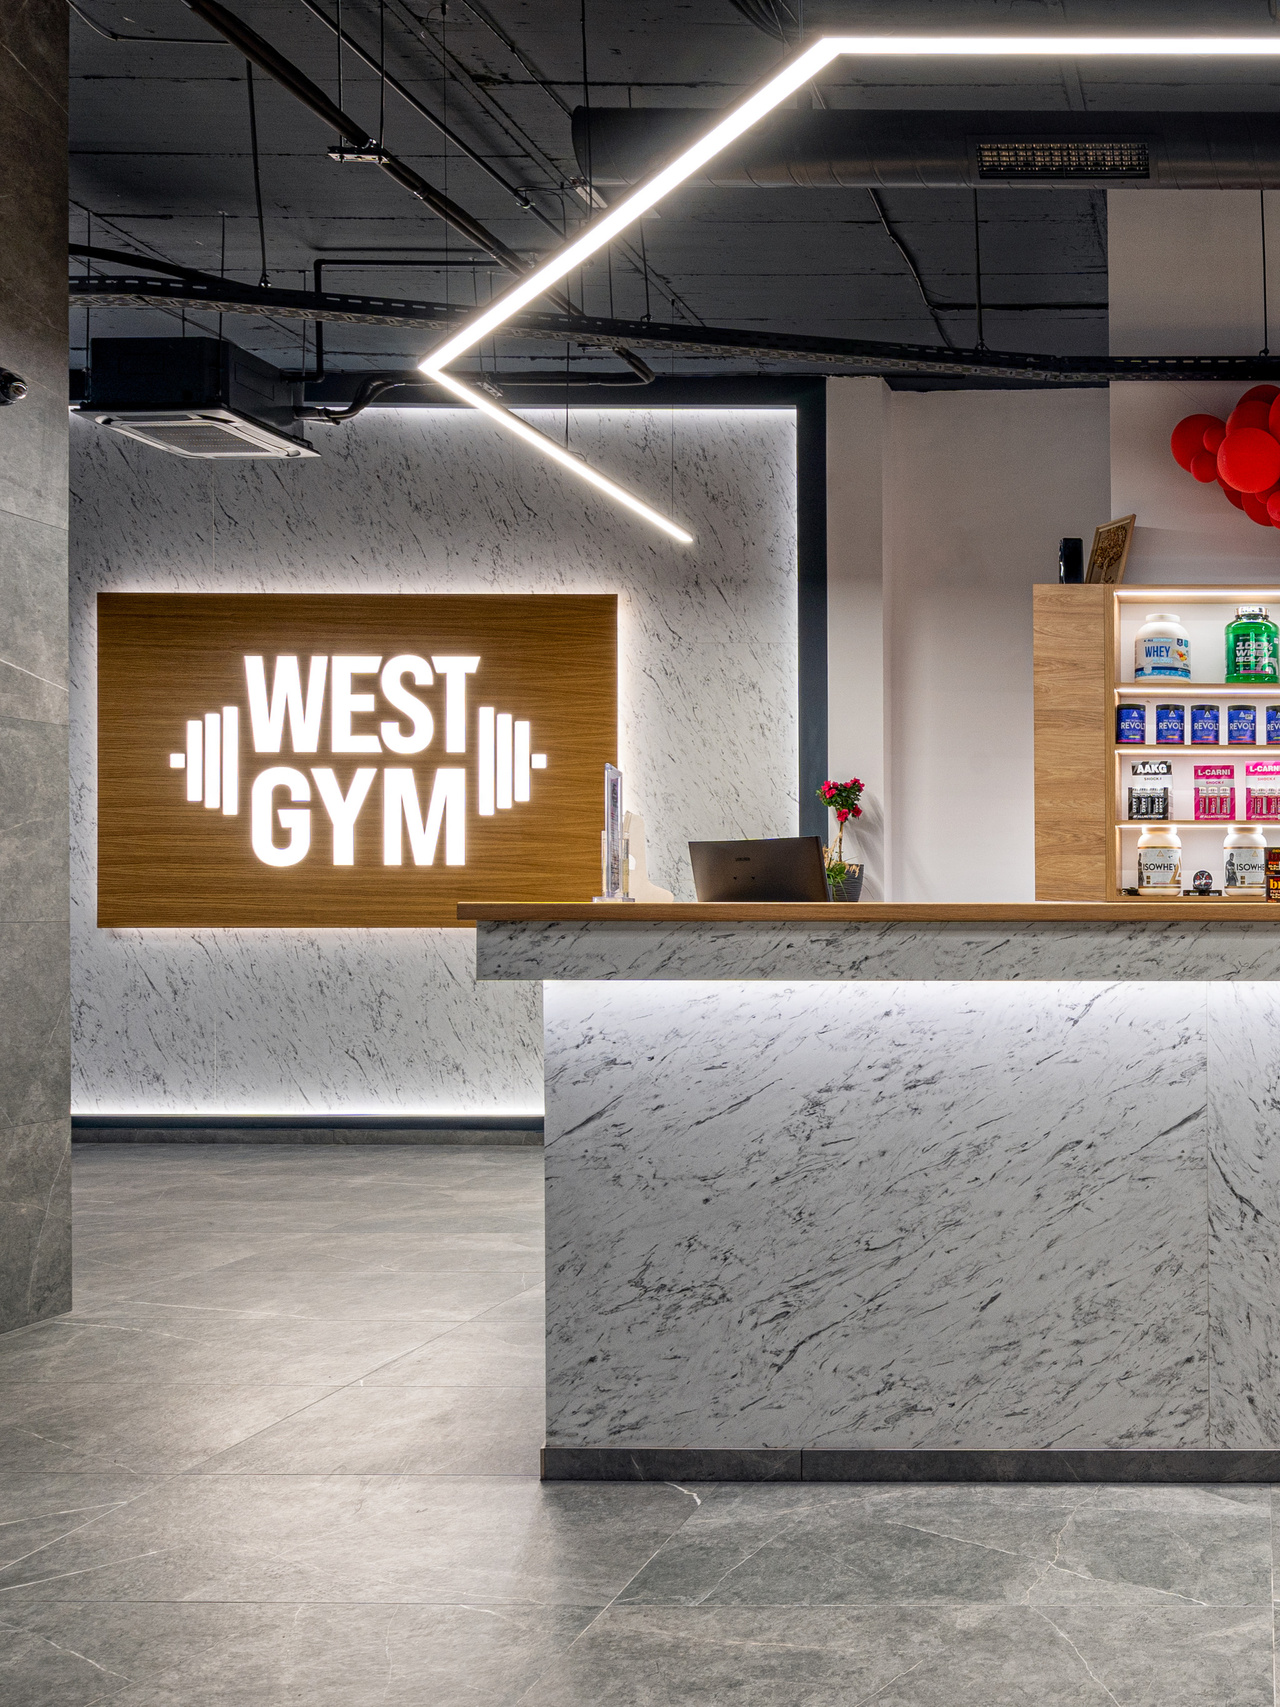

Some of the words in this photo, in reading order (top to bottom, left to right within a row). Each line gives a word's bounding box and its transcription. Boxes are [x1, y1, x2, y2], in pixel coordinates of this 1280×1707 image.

[1236, 641, 1274, 651] 100%
[1145, 645, 1171, 658] WHEY
[244, 654, 481, 754] WEST
[1229, 722, 1255, 731] REVOLT
[1136, 764, 1168, 774] AAKG
[252, 766, 466, 867] GYM
[1143, 863, 1177, 871] ISOWHEY
